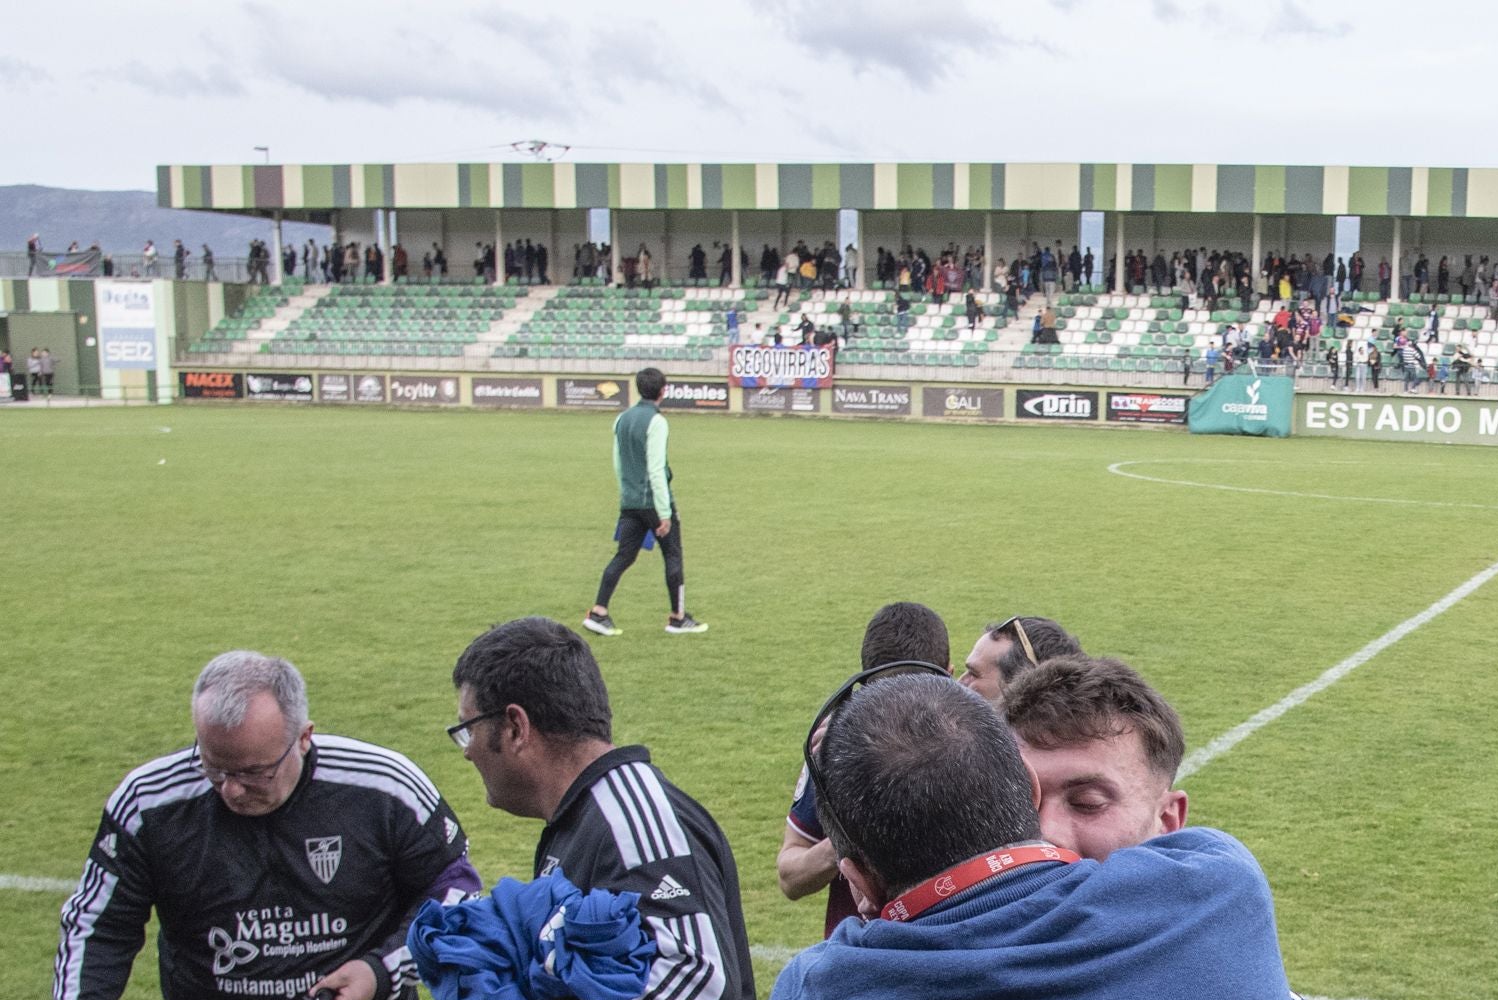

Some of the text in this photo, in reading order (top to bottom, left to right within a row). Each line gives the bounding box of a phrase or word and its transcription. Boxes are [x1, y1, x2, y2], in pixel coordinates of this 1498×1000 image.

[735, 349, 830, 377] SEGOVIRRAS
[185, 373, 234, 388] NACEX
[835, 389, 909, 405] NAVA TRANS
[944, 395, 981, 410] GALI
[1305, 401, 1462, 435] ESTADIO
[651, 886, 691, 900] adidas
[235, 905, 294, 922] venta
[894, 900, 910, 921] COPA
[236, 912, 348, 944] Magullo
[263, 936, 348, 958] Complejo Hostelero
